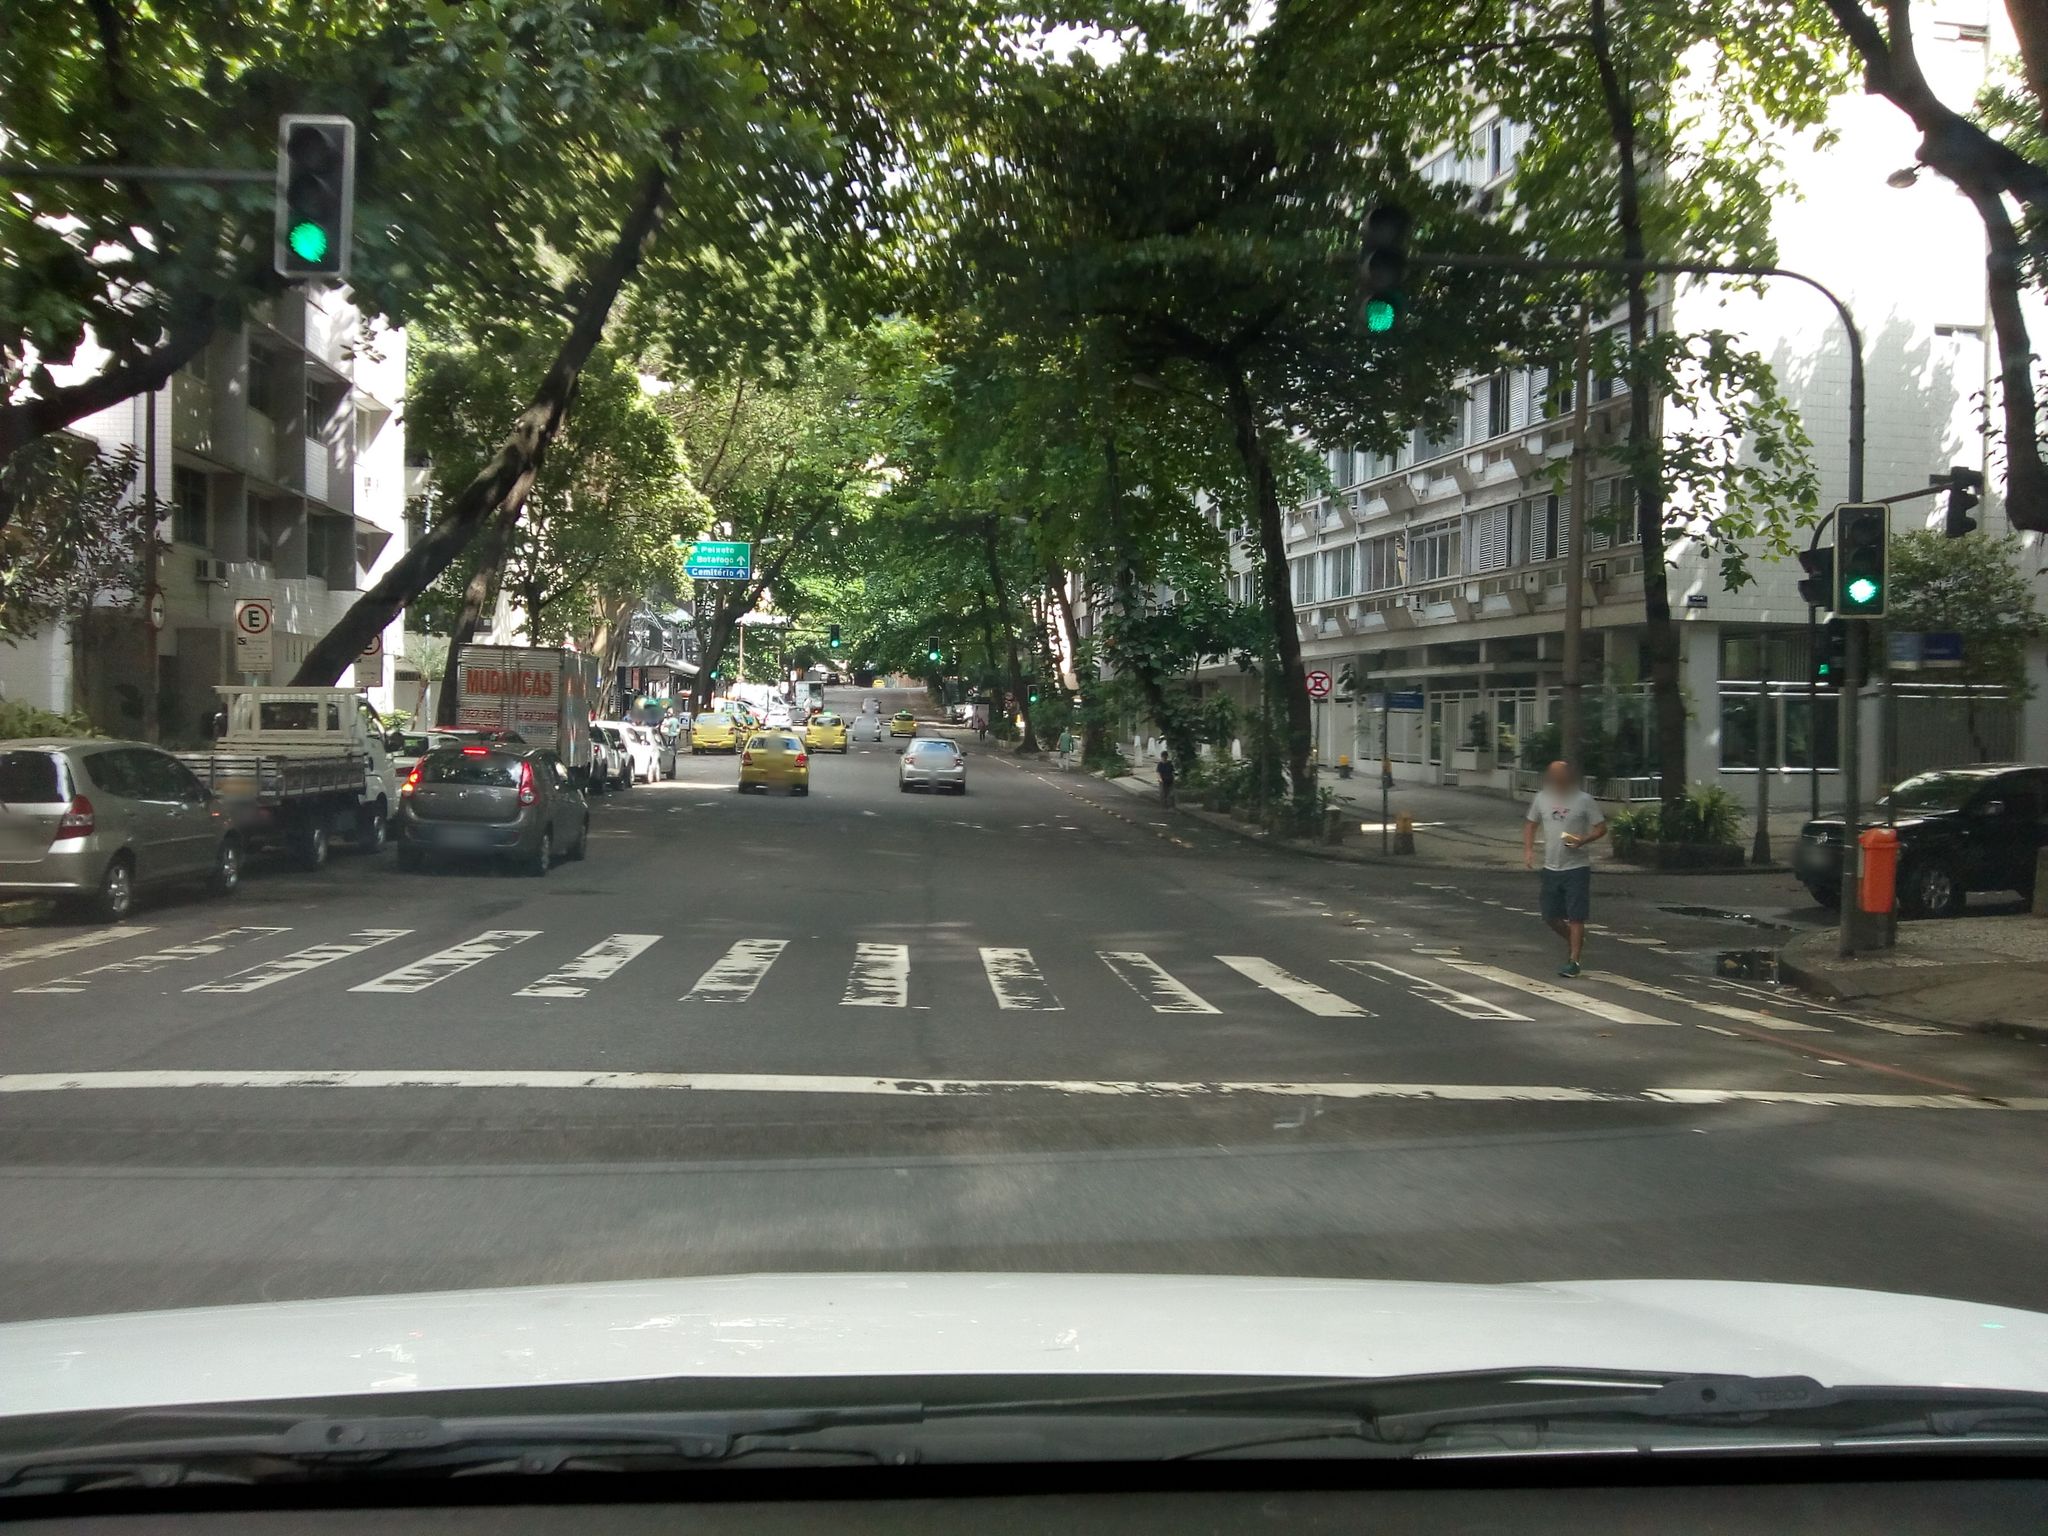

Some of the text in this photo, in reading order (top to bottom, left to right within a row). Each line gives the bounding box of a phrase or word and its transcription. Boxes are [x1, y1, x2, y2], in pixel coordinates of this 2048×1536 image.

[701, 546, 735, 554] Peixoto
[696, 556, 734, 565] Botafogo
[691, 568, 734, 576] Cemitério
[248, 610, 260, 627] E
[466, 667, 552, 697] MUDANÇAS
